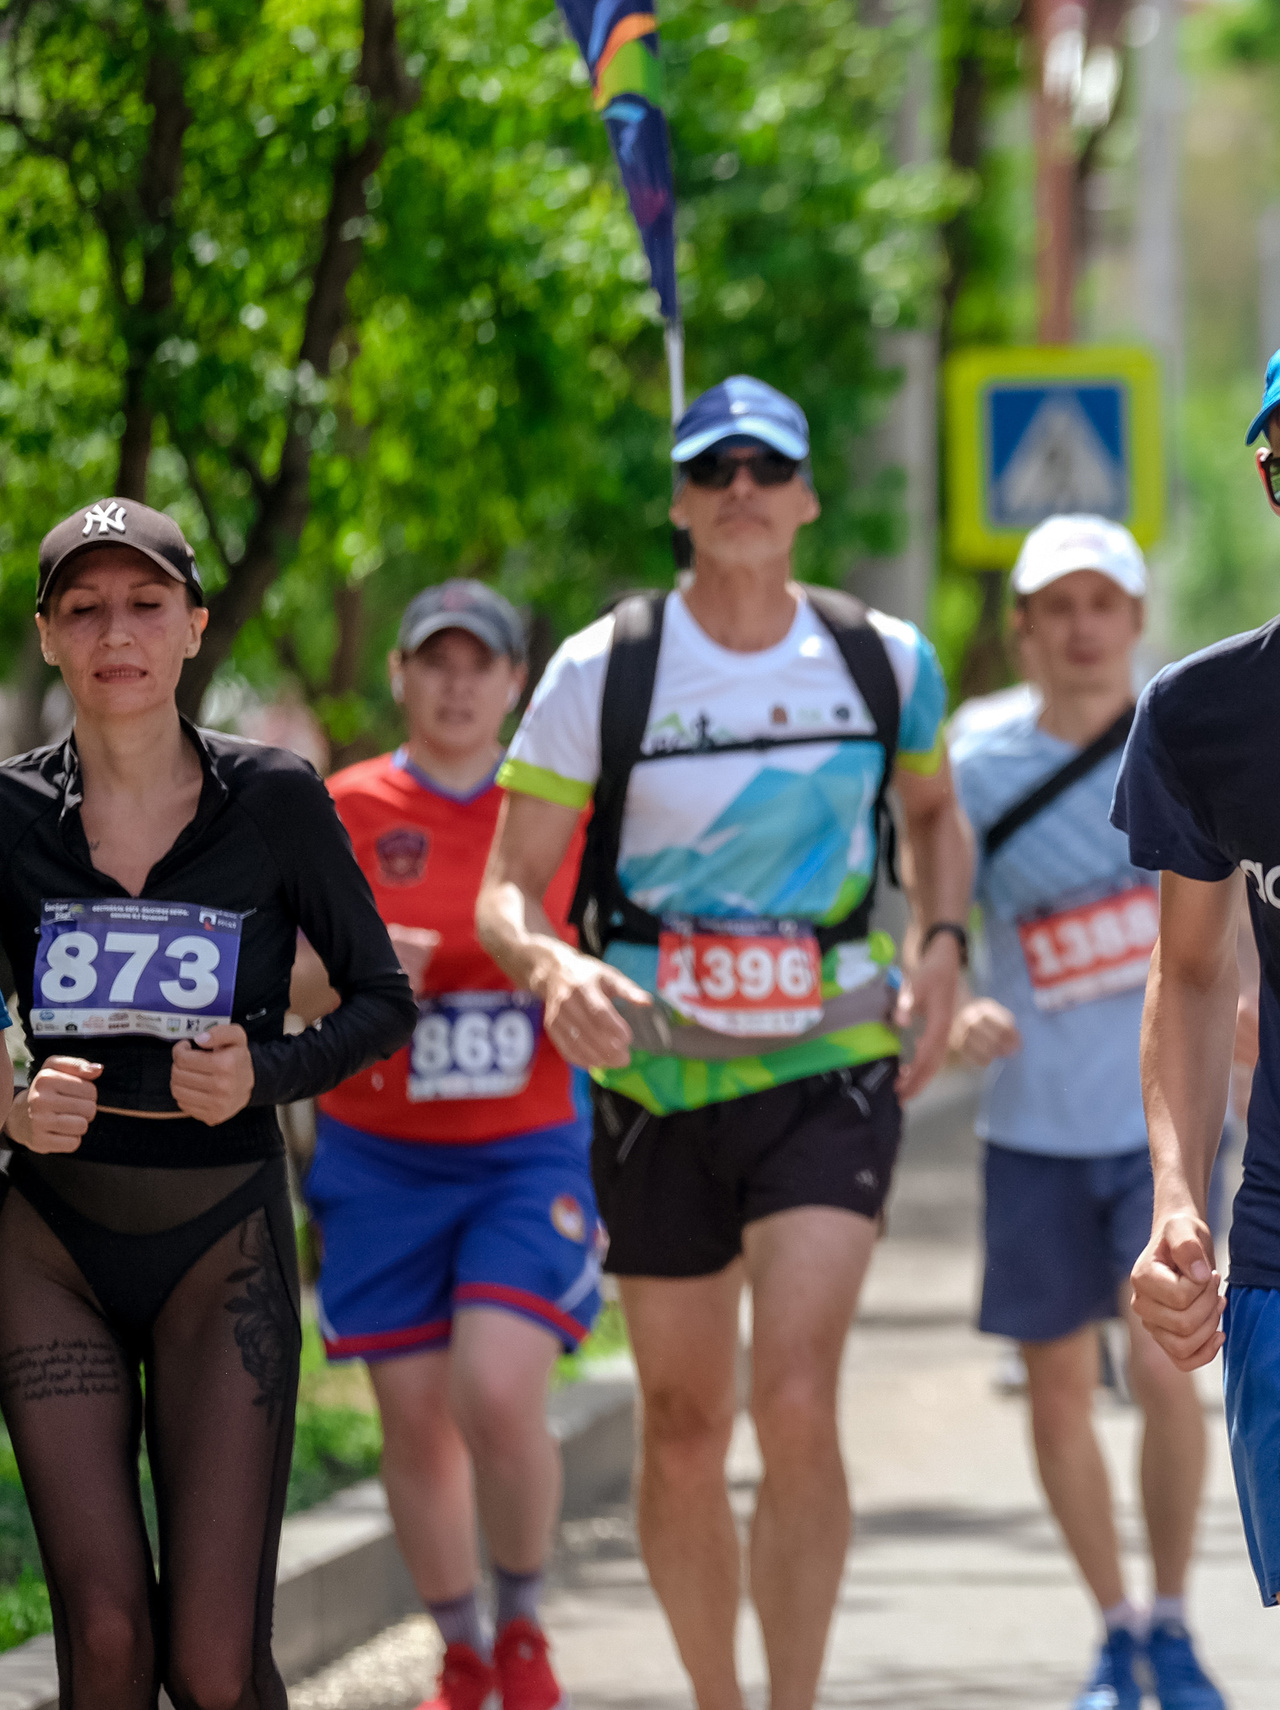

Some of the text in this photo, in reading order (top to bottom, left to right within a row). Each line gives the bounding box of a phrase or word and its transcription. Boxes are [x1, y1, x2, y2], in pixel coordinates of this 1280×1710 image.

[82, 502, 127, 537] NY
[40, 931, 221, 1010] 873
[667, 944, 813, 1001] 1396
[410, 1009, 535, 1078] 869
